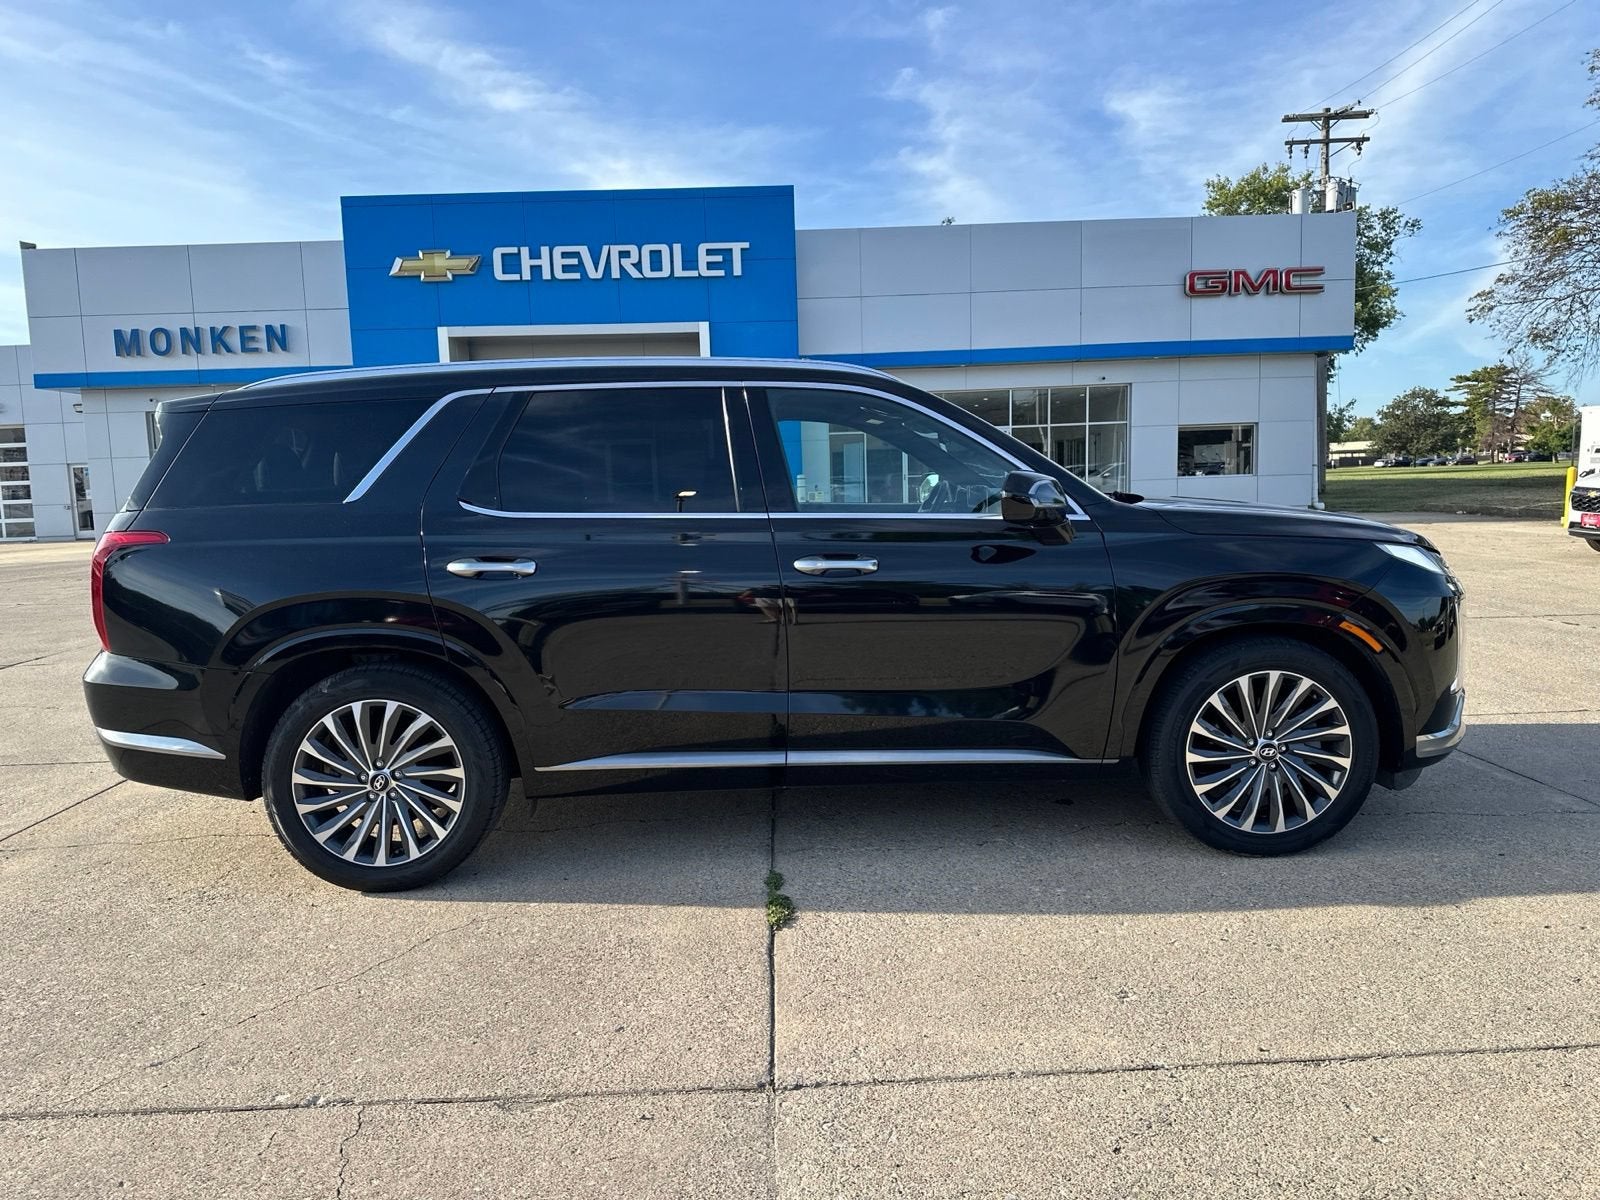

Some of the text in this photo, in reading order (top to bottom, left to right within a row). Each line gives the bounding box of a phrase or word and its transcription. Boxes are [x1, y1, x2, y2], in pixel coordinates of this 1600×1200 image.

[492, 241, 750, 281] CHEVROLET
[1184, 266, 1325, 297] GMC
[113, 323, 290, 357] MONKEN
